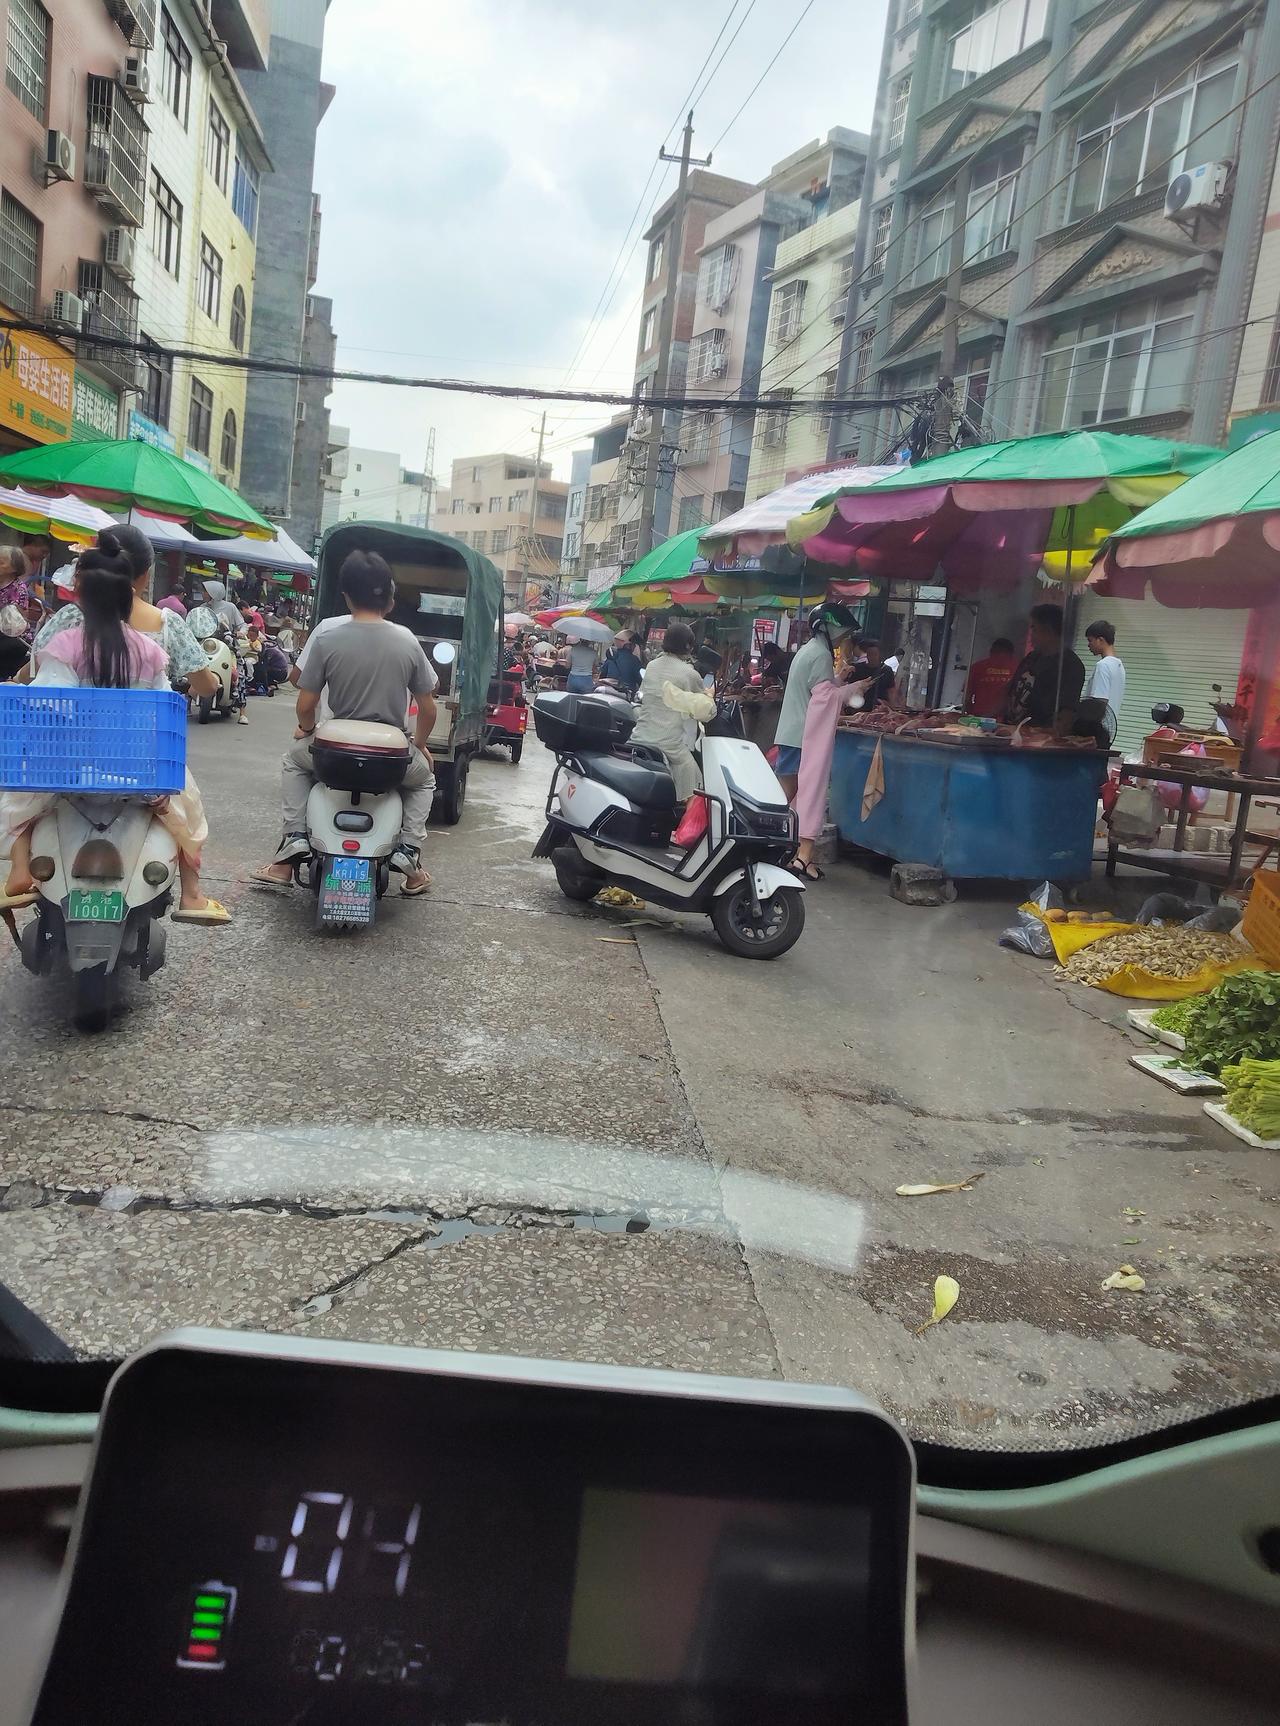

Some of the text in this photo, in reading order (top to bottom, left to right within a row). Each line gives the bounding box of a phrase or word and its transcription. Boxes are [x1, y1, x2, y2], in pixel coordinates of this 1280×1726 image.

[18, 344, 70, 413] 母婴生活馆
[75, 905, 119, 919] 10017
